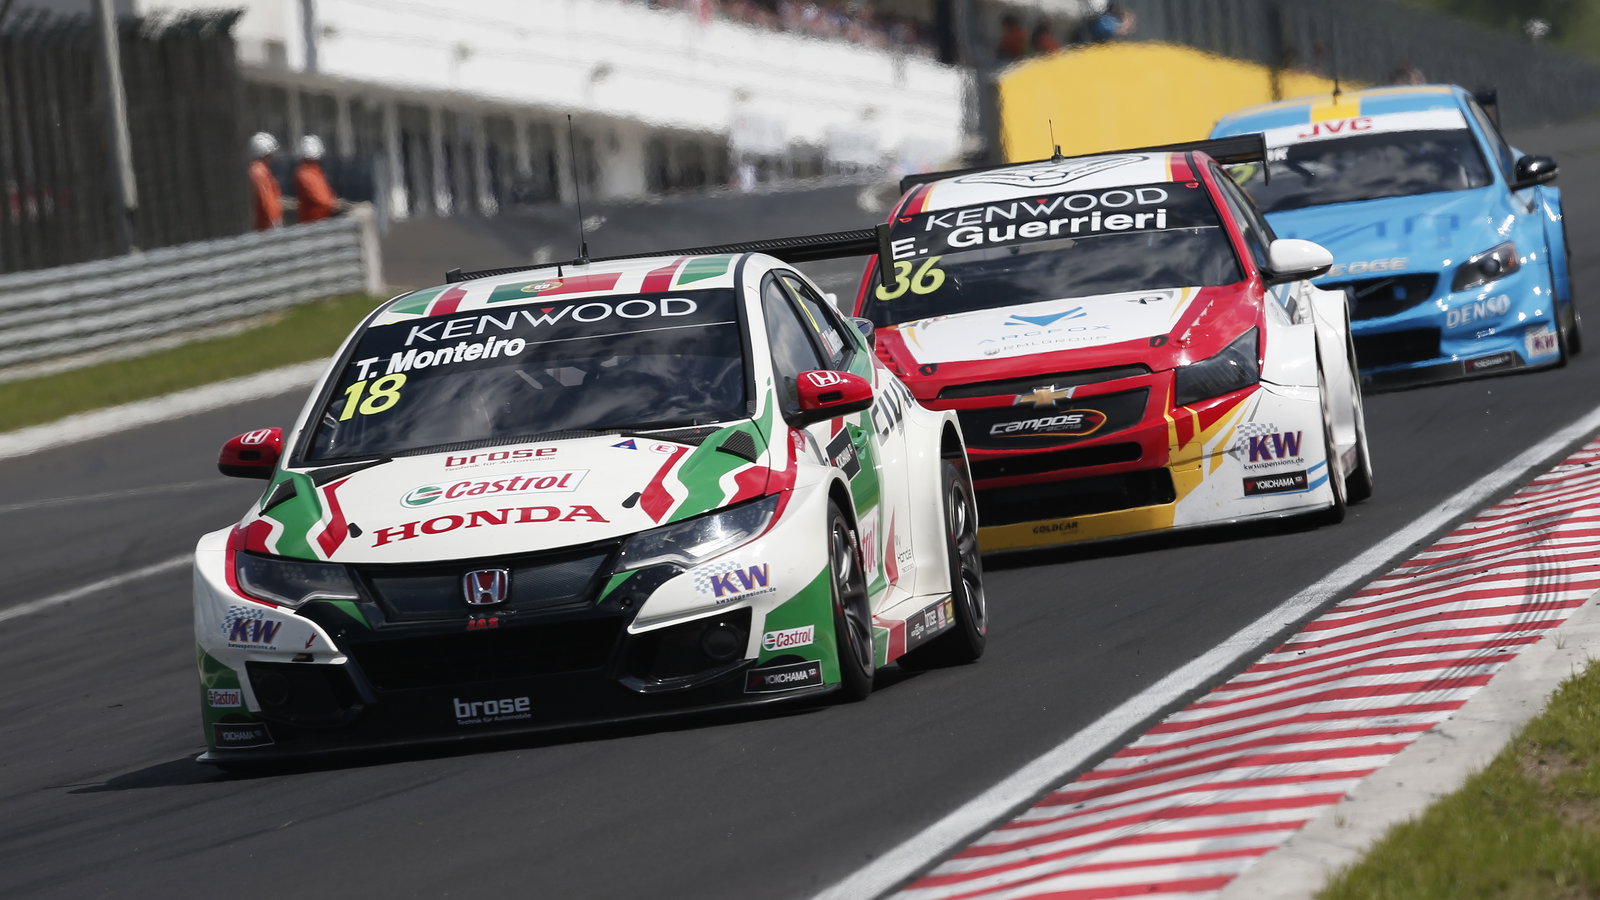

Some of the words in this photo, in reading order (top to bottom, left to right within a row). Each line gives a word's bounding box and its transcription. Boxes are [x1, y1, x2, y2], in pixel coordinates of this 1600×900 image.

[1297, 117, 1372, 138] JVC
[925, 187, 1168, 231] KENWOOD
[891, 237, 929, 260] E.
[946, 208, 1167, 248] Guerrieri
[875, 255, 946, 301] 36
[1327, 257, 1408, 277] EDGE
[404, 298, 698, 346] KENWOOD
[1446, 294, 1511, 328] DENSO
[356, 356, 379, 381] T.
[385, 335, 526, 375] Monteiro
[338, 373, 407, 421] 18
[989, 414, 1084, 435] campos
[445, 447, 558, 467] brose
[1249, 430, 1303, 462] KW
[444, 472, 573, 499] Castrol
[1256, 477, 1295, 490] YOKOHAMA
[371, 505, 611, 547] HONDA
[861, 514, 876, 574] trol
[711, 563, 769, 598] KW
[715, 587, 777, 605] kwsuspensions.de
[229, 617, 282, 644] KW
[776, 628, 811, 648] Castrol
[764, 670, 808, 684] YOKOHAMA
[214, 691, 240, 705] Castrol
[453, 696, 531, 718] brose
